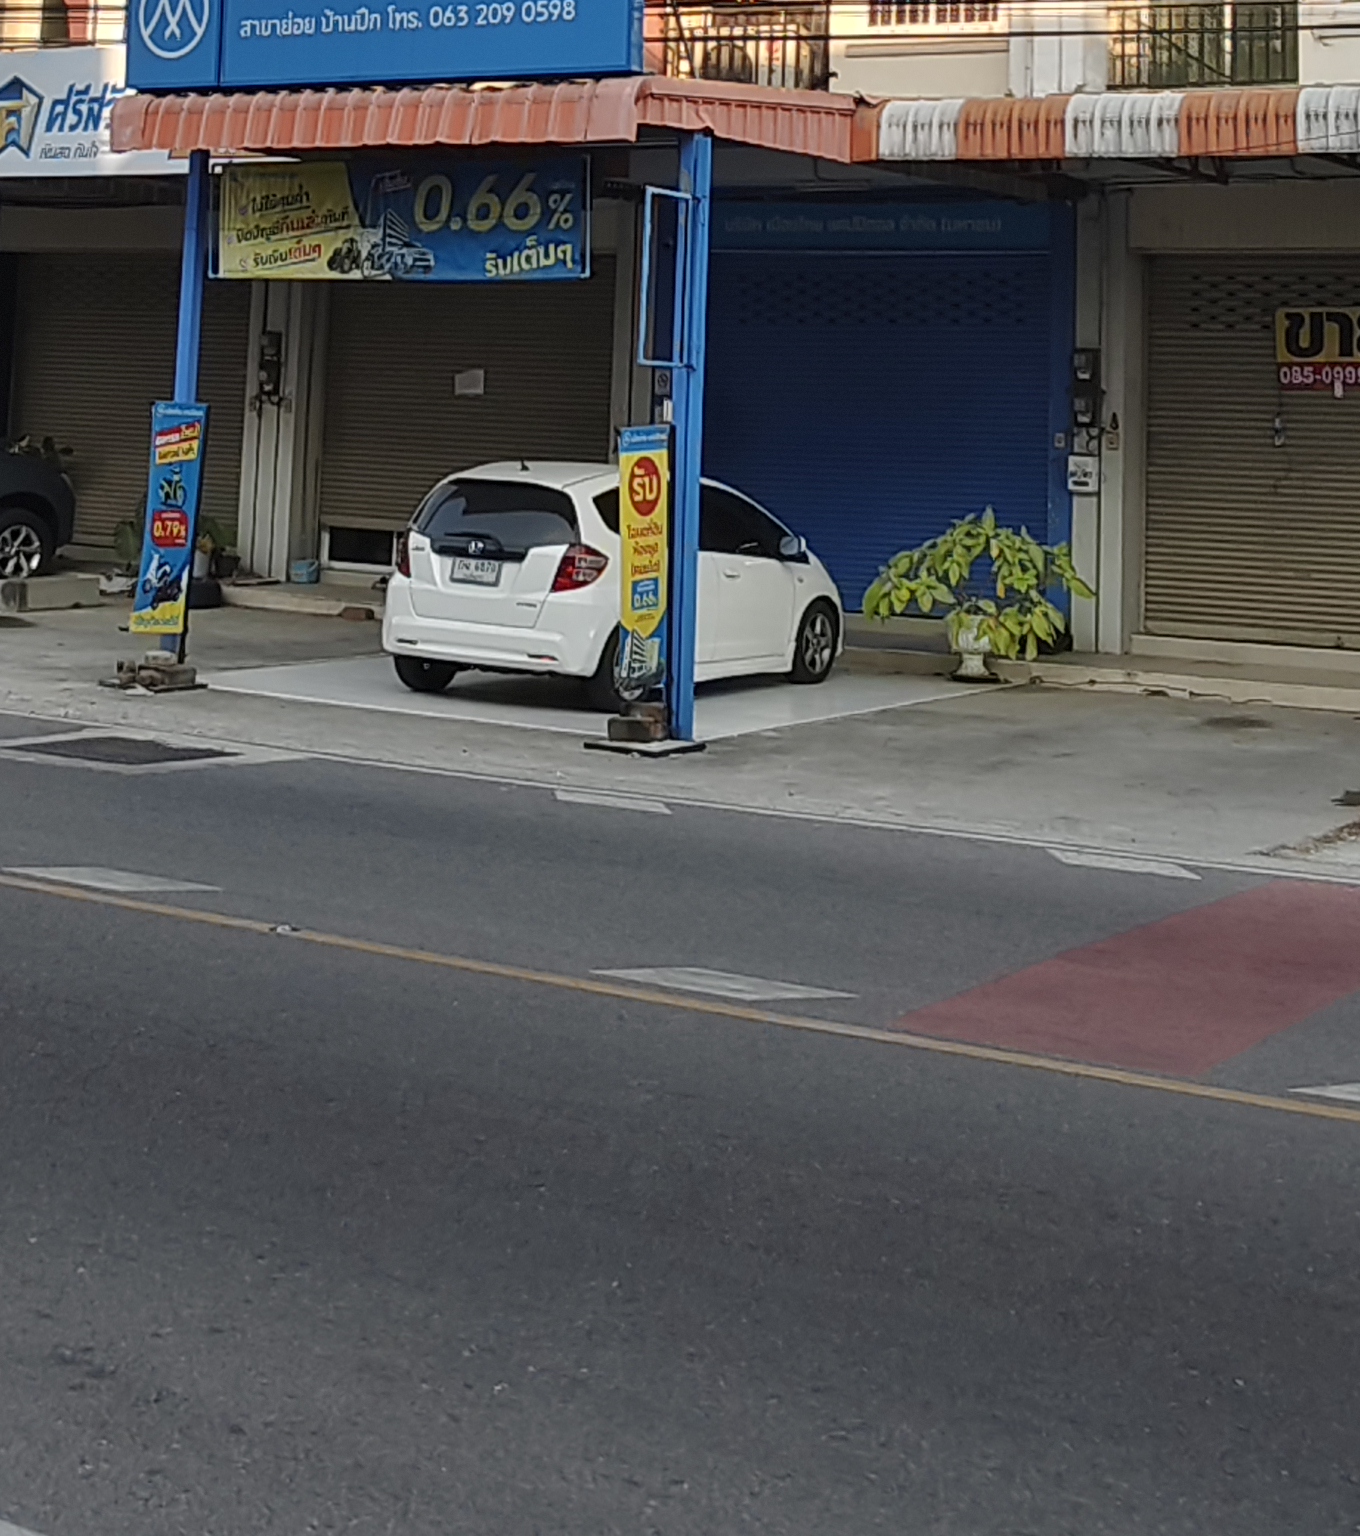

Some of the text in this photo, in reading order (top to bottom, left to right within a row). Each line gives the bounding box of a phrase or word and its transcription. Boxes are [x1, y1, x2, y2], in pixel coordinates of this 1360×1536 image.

[240, 8, 316, 38] สาขาย่อย
[388, 4, 423, 30] โทร.
[429, 2, 469, 29] 063
[475, 0, 515, 26] 209
[485, 234, 574, 278] รับเต็มๆ
[633, 465, 658, 502] รับ
